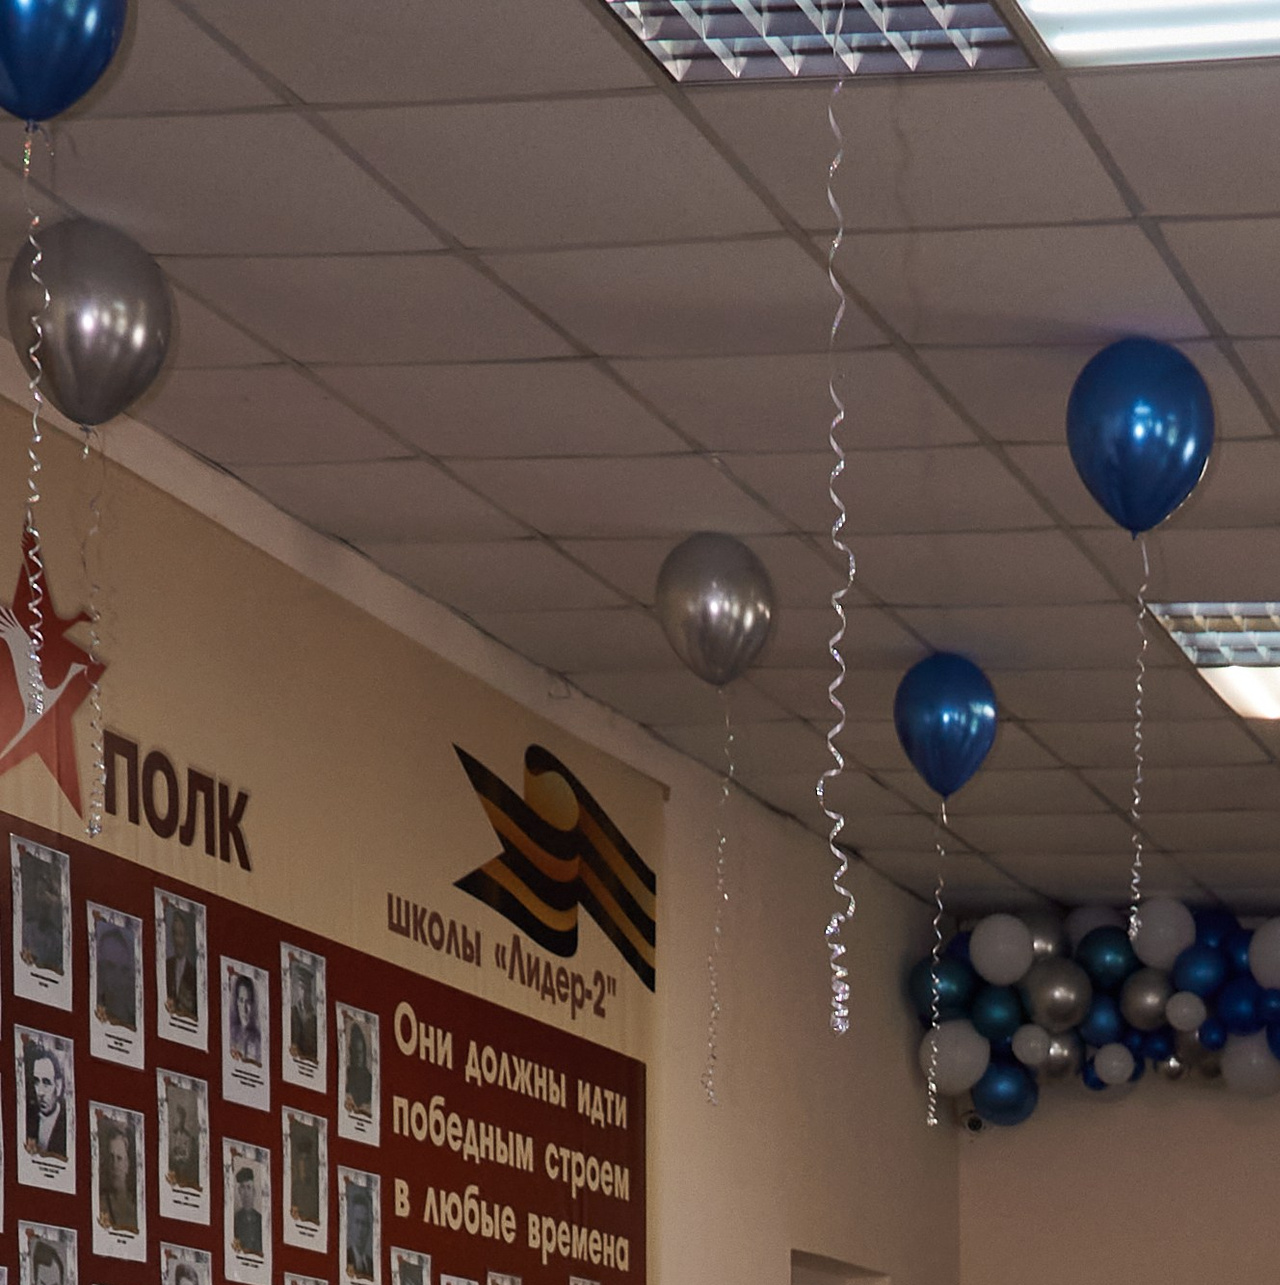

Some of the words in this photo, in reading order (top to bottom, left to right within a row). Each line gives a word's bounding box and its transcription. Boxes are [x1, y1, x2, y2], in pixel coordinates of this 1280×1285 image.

[103, 729, 252, 872] ПОЛК
[387, 892, 481, 967] школы
[394, 1001, 453, 1071] Они
[465, 1040, 567, 1109] должны
[577, 1079, 627, 1129] идти
[392, 1095, 534, 1172] победным
[545, 1142, 630, 1201] строем
[394, 1178, 411, 1217] в
[423, 1184, 517, 1244] любые
[528, 1212, 629, 1272] времена
